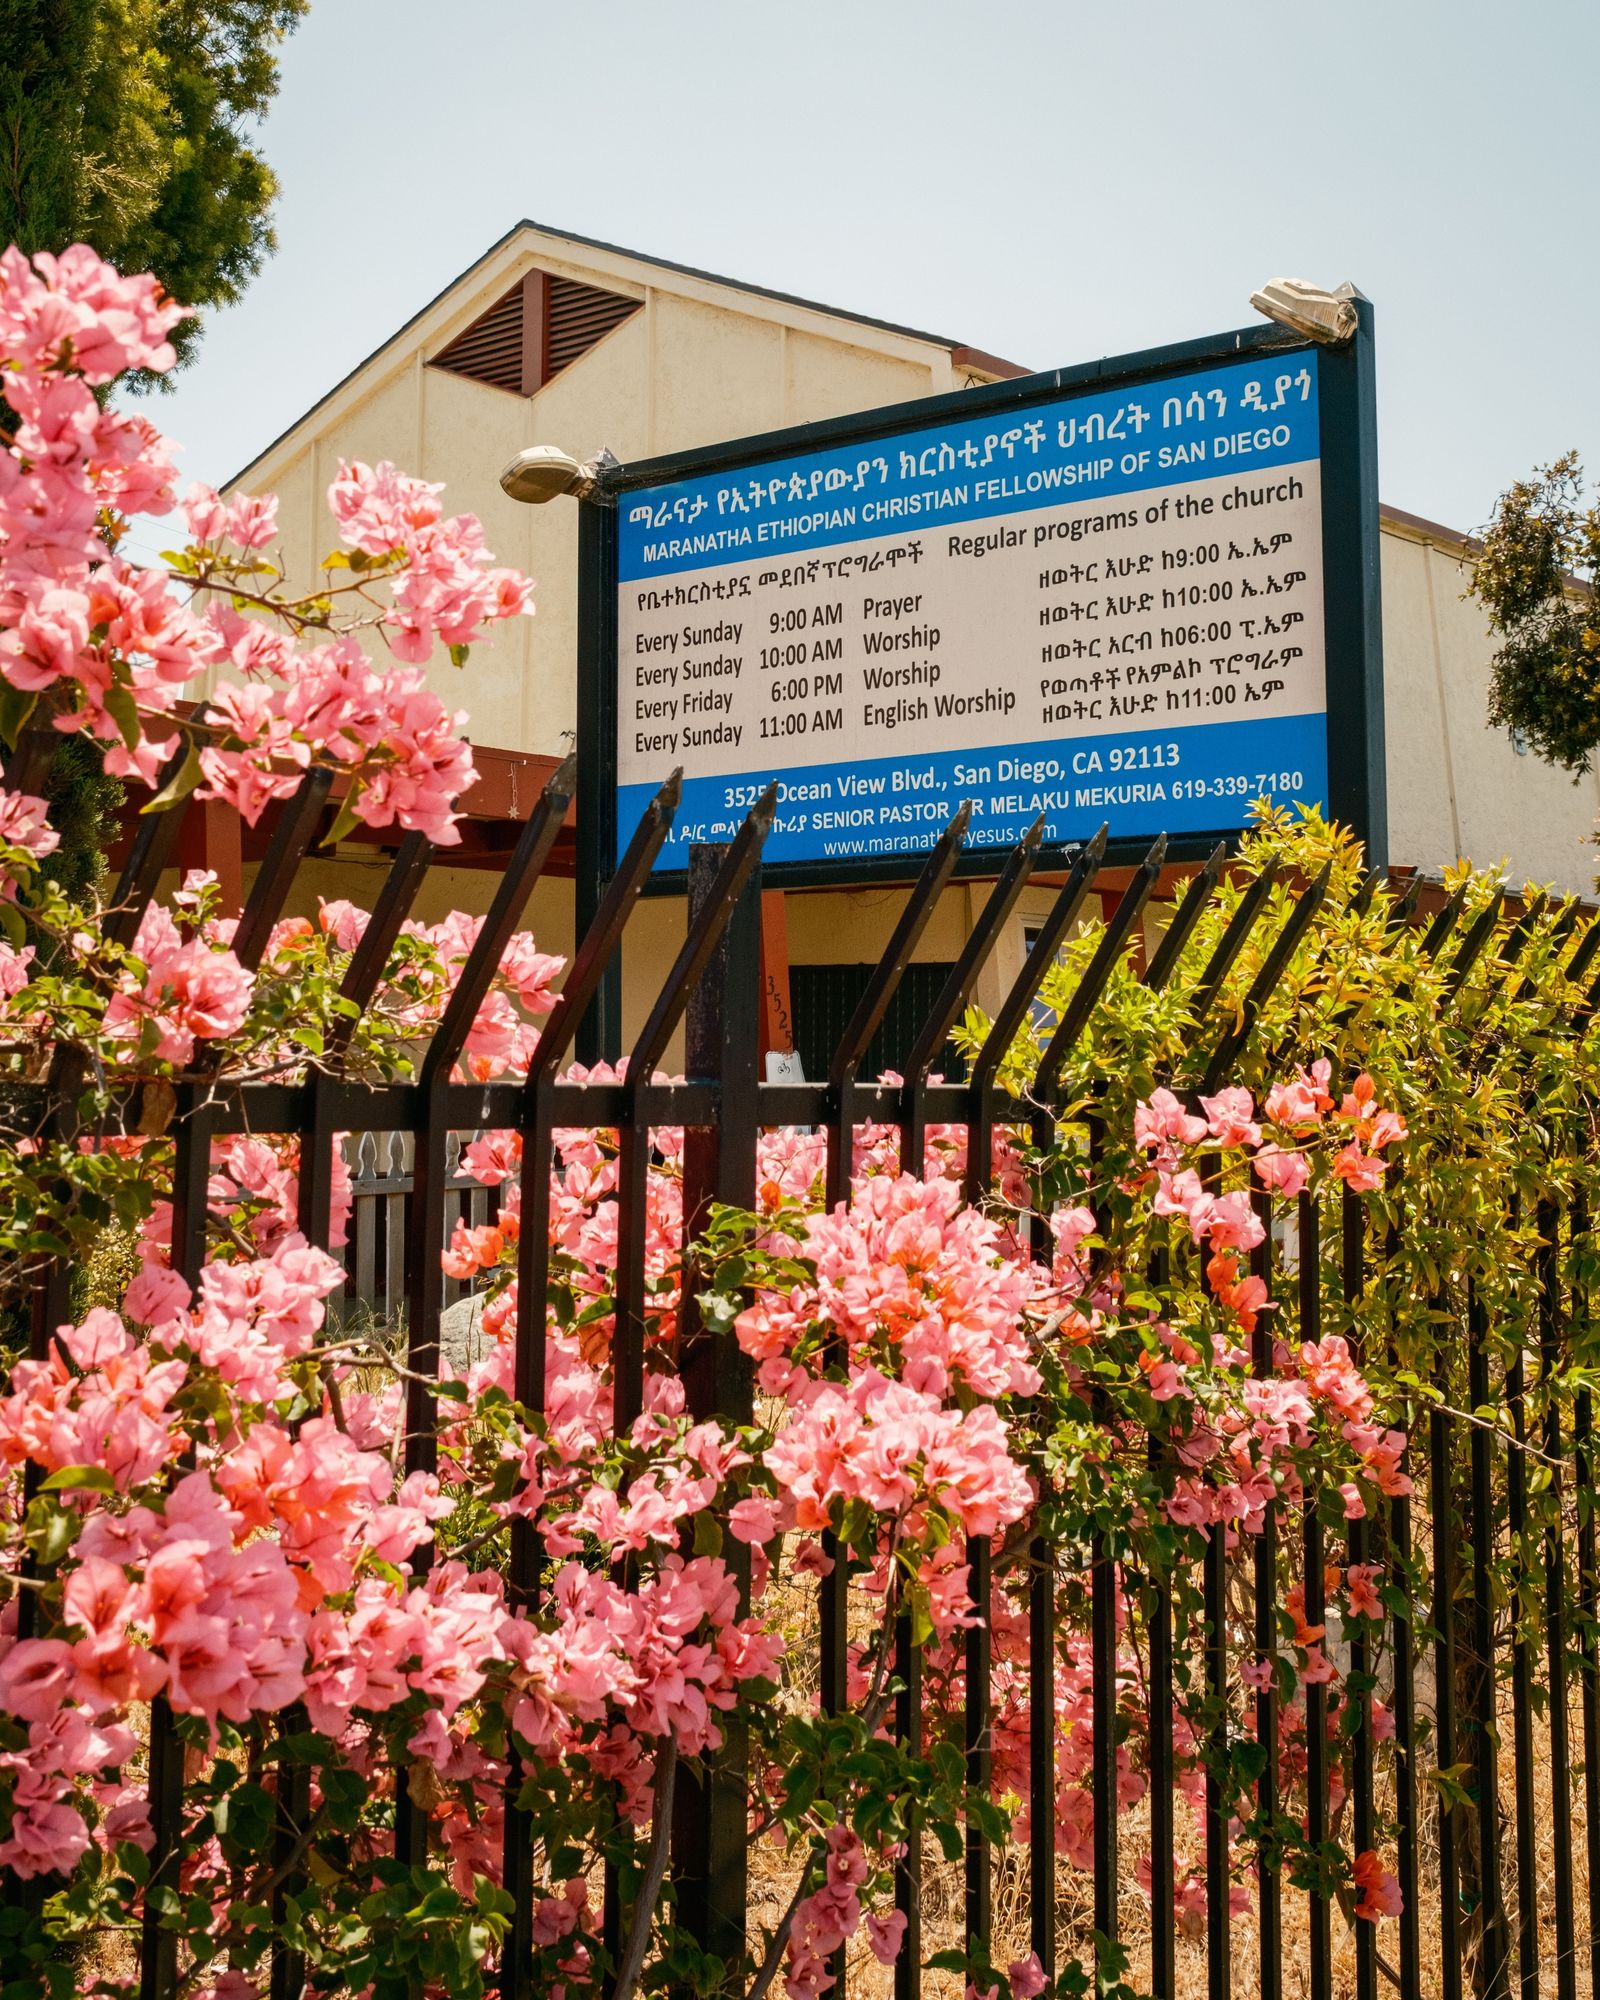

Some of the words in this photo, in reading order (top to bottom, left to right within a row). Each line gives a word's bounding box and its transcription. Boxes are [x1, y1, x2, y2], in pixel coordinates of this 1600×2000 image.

[629, 494, 709, 529] ማራናታ
[717, 457, 889, 515] የኢትዮጵያውያን
[899, 419, 1047, 480] ክርስቲያኖች
[1058, 403, 1151, 448] ህብረት
[1163, 388, 1227, 428] በሳን
[1240, 368, 1311, 413] ዲያጎ
[643, 527, 753, 563] MARANATHA
[757, 506, 856, 542] ETHIOPIAN
[862, 485, 968, 523] CHRISTIAN
[975, 458, 1114, 502] FELLOWSHIP
[1120, 450, 1151, 475] OF
[1158, 440, 1206, 468] SAN
[1213, 424, 1291, 458] DIEGO
[948, 526, 1028, 558] Regular
[1034, 510, 1138, 548] programs
[1145, 497, 1169, 524] of
[1174, 494, 1214, 519] the
[1221, 476, 1303, 511] church
[1039, 562, 1098, 589] ዘወትር
[1105, 554, 1154, 579] እሁድ
[1161, 543, 1220, 570] ከ9:00
[636, 633, 679, 655] Every
[682, 620, 743, 647] Sunday
[769, 608, 807, 634] 9:00
[811, 602, 843, 628] AM
[863, 594, 923, 621] Prayer
[1039, 600, 1099, 626] ዘወትር
[1105, 592, 1154, 617] እሁድ
[1162, 580, 1233, 609] ከ10:00
[636, 666, 679, 688] Every
[682, 653, 743, 681] Sunday
[760, 642, 807, 670] 10:00
[811, 637, 843, 663] AM
[863, 623, 941, 655] Worship
[1040, 667, 1121, 698] የወጣቶች
[1126, 657, 1202, 685] የአምልኮ
[1209, 646, 1304, 675] ፕሮግራም
[1042, 638, 1101, 663] ዘወትር
[1108, 631, 1152, 655] አርብ
[1160, 620, 1232, 648] ከ06:00
[635, 699, 679, 721] Every
[683, 688, 733, 714] Friday
[771, 677, 809, 703] 6:00
[814, 672, 843, 697] PM
[863, 660, 941, 690] Worship
[635, 732, 679, 754] Every
[682, 721, 743, 748] Sunday
[759, 712, 807, 739] 11:00
[811, 707, 843, 733] AM
[864, 696, 928, 729] English
[934, 687, 1016, 718] Worship
[1042, 699, 1102, 724] ዘወትር
[1109, 693, 1158, 717] እሁድ
[1166, 684, 1236, 711] ከ11:00
[1244, 679, 1285, 703] ኤም
[775, 782, 832, 803] Ocean
[837, 774, 886, 797] View
[892, 766, 947, 792] Blvd.,
[953, 764, 991, 786] San
[998, 758, 1066, 784] Diego,
[1072, 751, 1104, 775] CA
[1109, 743, 1180, 772] 92113
[710, 819, 743, 837] መላ
[812, 808, 875, 830] SENIOR
[879, 801, 950, 824] PASTOR
[991, 790, 1069, 815] MELAKU
[1075, 782, 1167, 807] MEKURIA
[1172, 771, 1303, 800] 619-339-7180
[824, 824, 1057, 855] www.maranathyesus.cm
[765, 975, 793, 1049] 3525
